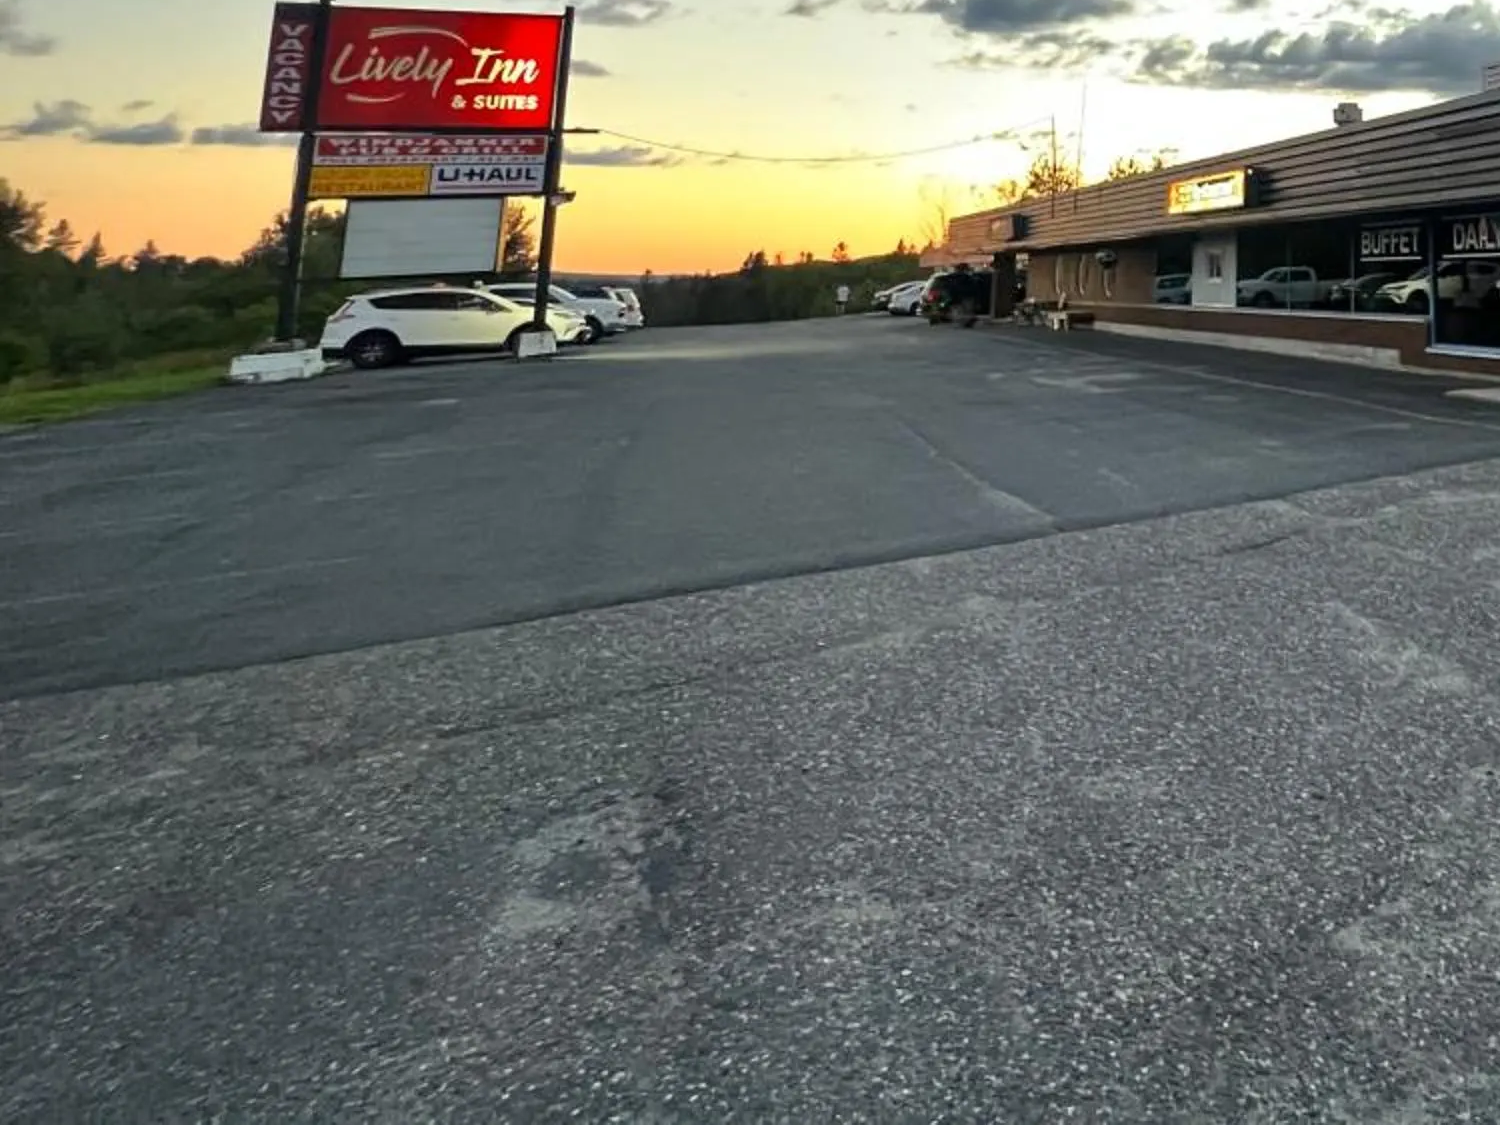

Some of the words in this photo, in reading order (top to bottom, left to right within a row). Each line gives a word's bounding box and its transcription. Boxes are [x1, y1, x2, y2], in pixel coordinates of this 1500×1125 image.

[269, 24, 308, 123] VACANCY
[330, 43, 453, 99] Lively
[455, 47, 540, 86] Inn
[451, 94, 467, 111] &
[473, 94, 539, 111] SUITES
[327, 137, 537, 147] WINDJAMMER
[338, 146, 400, 155] PUB
[440, 145, 528, 155] GRILL
[437, 167, 538, 182] U-HAUL
[1360, 227, 1421, 255] BUFFET
